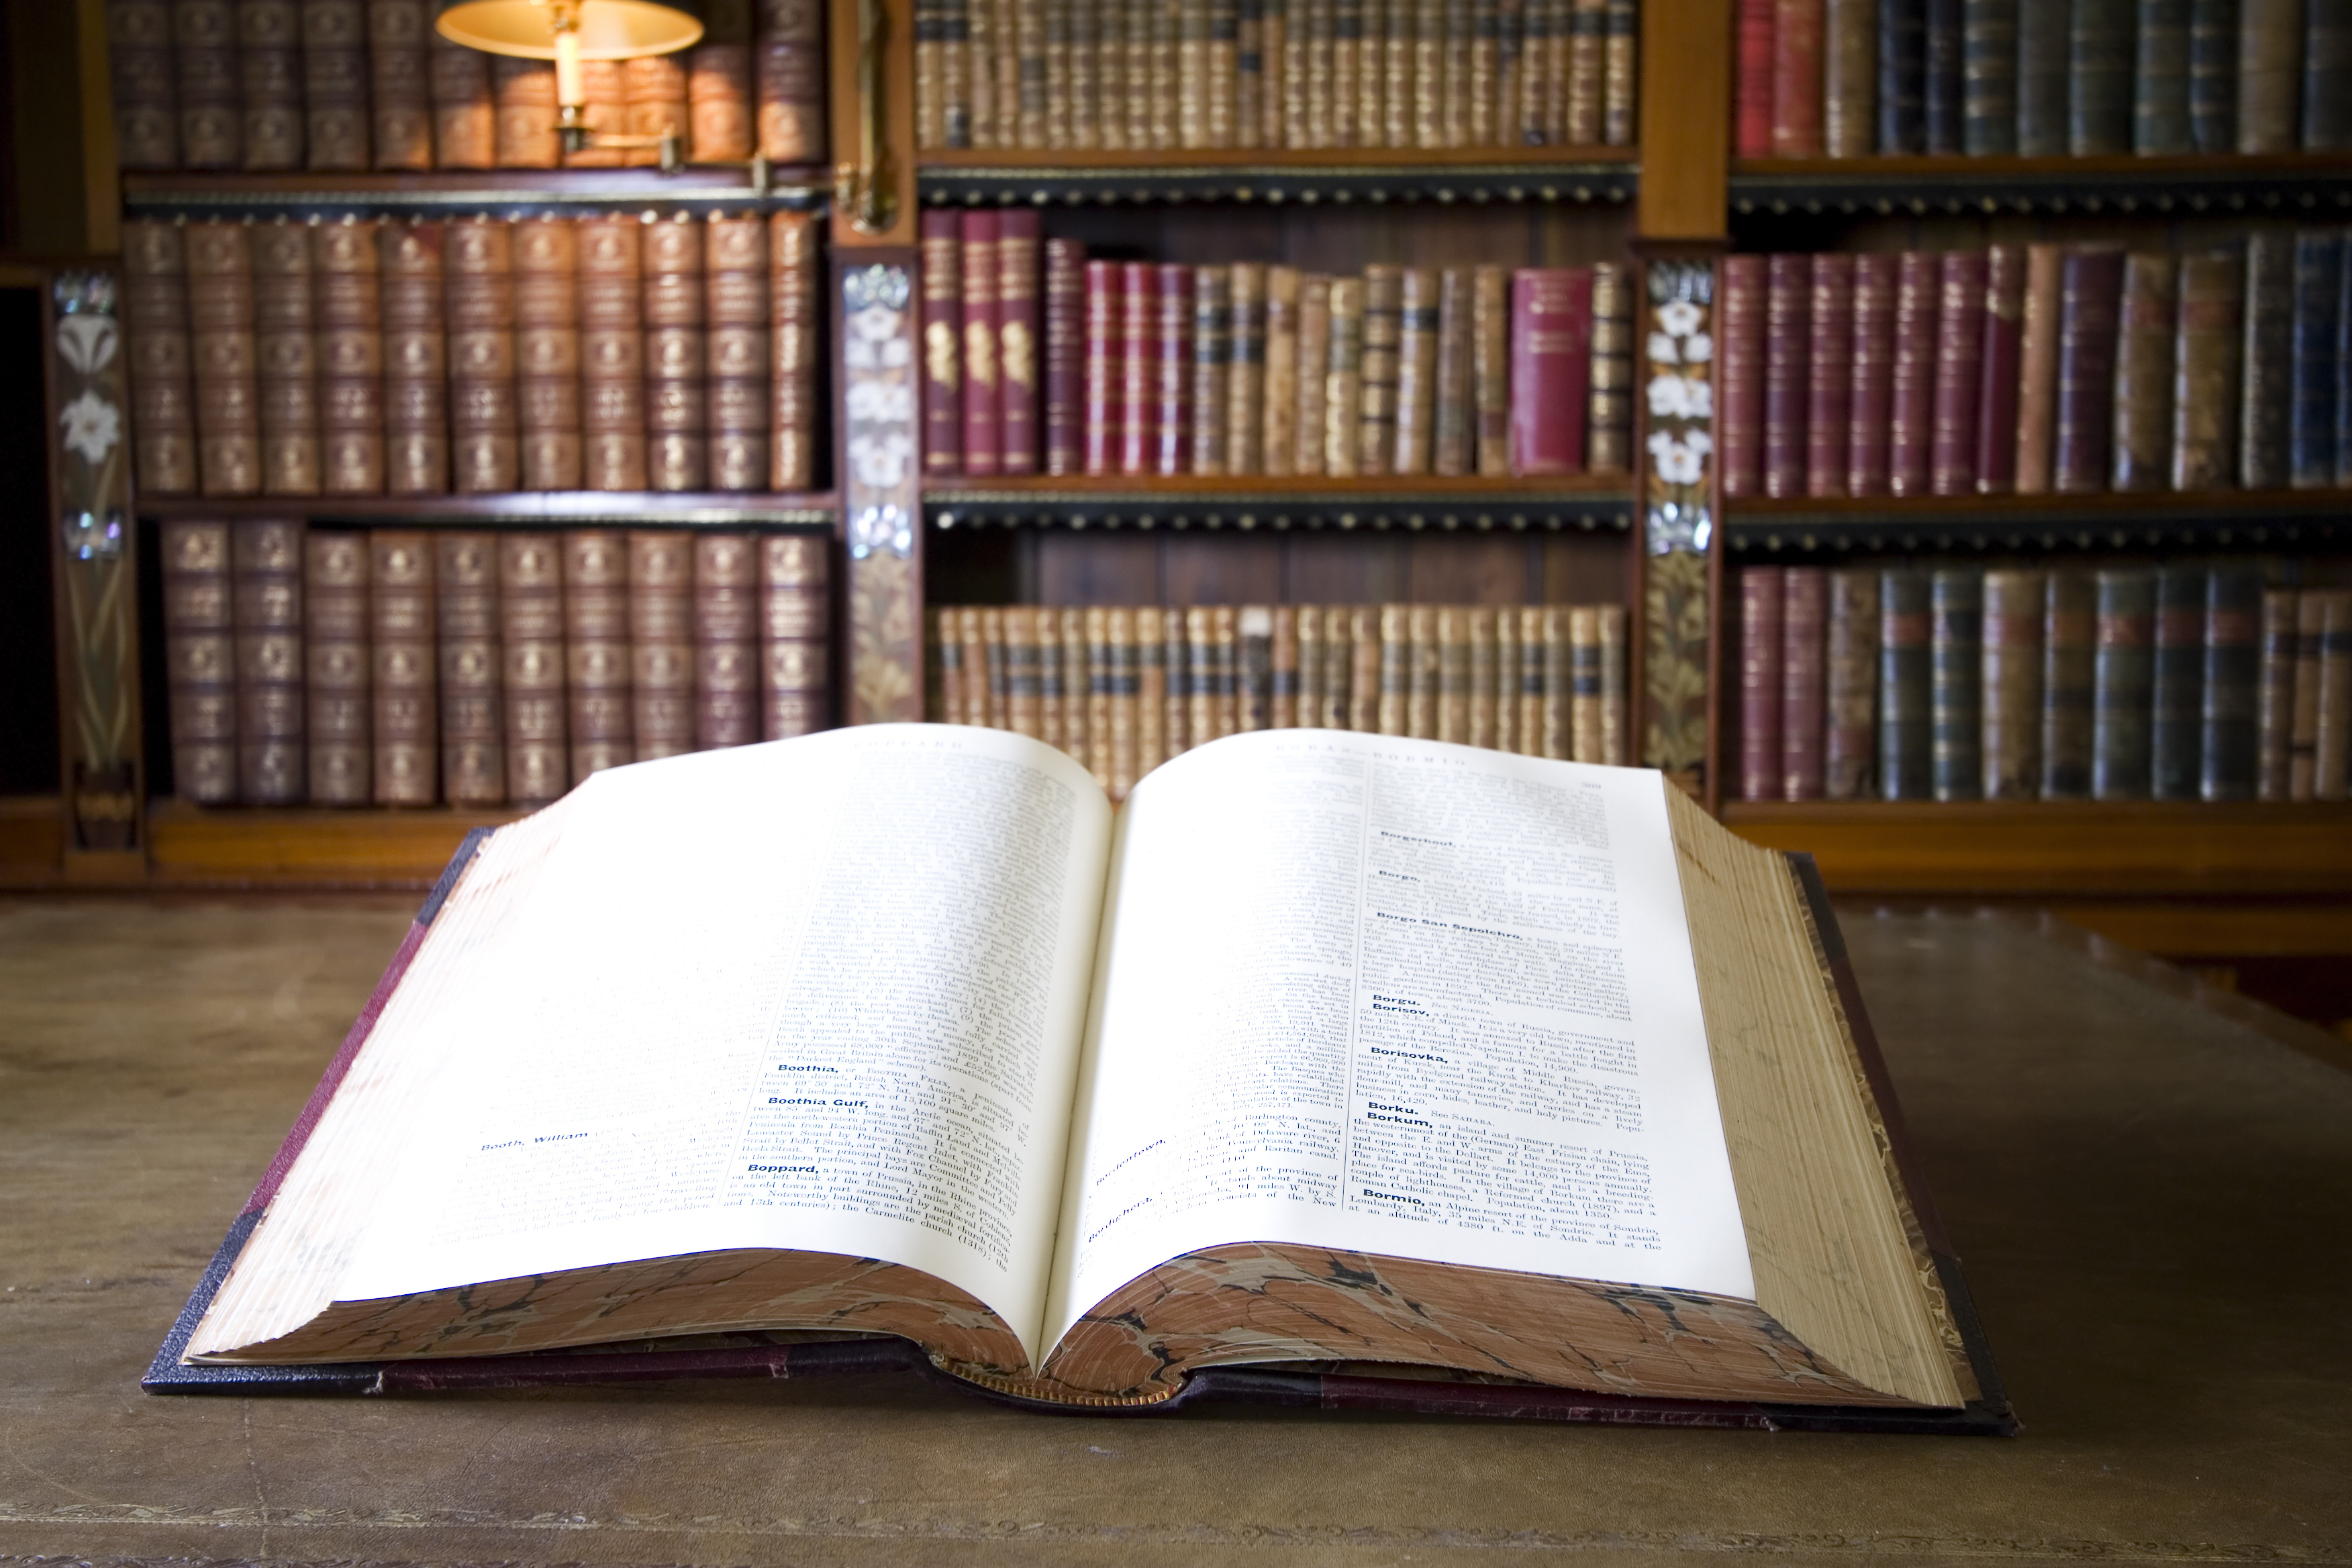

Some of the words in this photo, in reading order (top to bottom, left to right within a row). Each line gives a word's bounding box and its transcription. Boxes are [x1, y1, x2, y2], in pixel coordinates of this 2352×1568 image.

[1381, 832, 1457, 848] Borgerhout,
[1379, 871, 1420, 882] Borgo,
[1377, 912, 1417, 922] Borgo
[1373, 995, 1420, 1006] Borgu.
[1373, 1003, 1429, 1017] Borisov,
[1443, 1012, 1476, 1022] district
[1522, 1024, 1555, 1034] Russia,
[1559, 1031, 1614, 1042] government
[1371, 1047, 1448, 1064] Borisovka,
[1468, 1061, 1499, 1070] village
[1522, 1068, 1555, 1079] Middle
[1563, 1076, 1598, 1088] Russia,
[1604, 1085, 1640, 1094] govern-
[769, 1097, 826, 1106] Boothia
[833, 1099, 869, 1109] Gulf,
[854, 1075, 886, 1083] British
[892, 1078, 921, 1088] North
[928, 1085, 967, 1102] America,
[983, 1106, 1014, 1127] situated
[975, 1093, 1012, 1117] peninsula
[1022, 1122, 1029, 1130] of
[1368, 1102, 1418, 1115] Borku.
[1431, 1110, 1448, 1118] See
[903, 1095, 936, 1108] 13,100
[938, 1106, 969, 1119] square
[972, 1116, 995, 1132] miles.
[1367, 1112, 1433, 1128] Borkum,
[481, 1140, 525, 1150] Booth,
[534, 1132, 588, 1143] William
[1279, 1167, 1322, 1178] province
[1297, 1177, 1337, 1190] midway
[748, 1165, 819, 1174] Boppard,
[877, 1172, 914, 1187] Prussia,
[931, 1185, 946, 1195] the
[949, 1191, 976, 1210] Rhine
[980, 1208, 1012, 1237] province,
[856, 1188, 913, 1204] surrounded
[918, 1199, 930, 1210] by
[1288, 1193, 1304, 1201] the
[1313, 1197, 1336, 1207] New
[1289, 1184, 1302, 1193] W.
[1308, 1187, 1320, 1197] by
[866, 1180, 899, 1193] Rhine,
[905, 1187, 918, 1195] 12
[924, 1193, 948, 1206] miles
[954, 1203, 962, 1213] S.
[967, 1209, 975, 1218] of
[980, 1216, 1010, 1246] Coblenz,
[1349, 1195, 1406, 1211] Lombardy,
[1414, 1206, 1441, 1217] Italy,
[1468, 1215, 1496, 1224] miles
[1502, 1219, 1526, 1228] N.E.
[1551, 1226, 1594, 1236] Sondrio.
[1363, 1189, 1424, 1206] Bormio,
[1483, 1208, 1513, 1218] resort
[1552, 1218, 1596, 1228] province
[1614, 1224, 1659, 1236] Sondrio,
[767, 1190, 829, 1201] Noteworthy
[833, 1193, 881, 1207] buildings
[885, 1202, 899, 1210] are
[905, 1206, 921, 1216] the
[926, 1211, 953, 1228] parish
[957, 1226, 985, 1245] church
[989, 1242, 1008, 1264] (12th
[1389, 1211, 1429, 1223] altitude
[1458, 1221, 1483, 1230] 4380
[1559, 1234, 1587, 1243] Adda
[842, 1204, 859, 1212] the
[865, 1207, 914, 1224] Carmelite
[921, 1220, 952, 1236] church
[996, 1259, 1008, 1273] the
